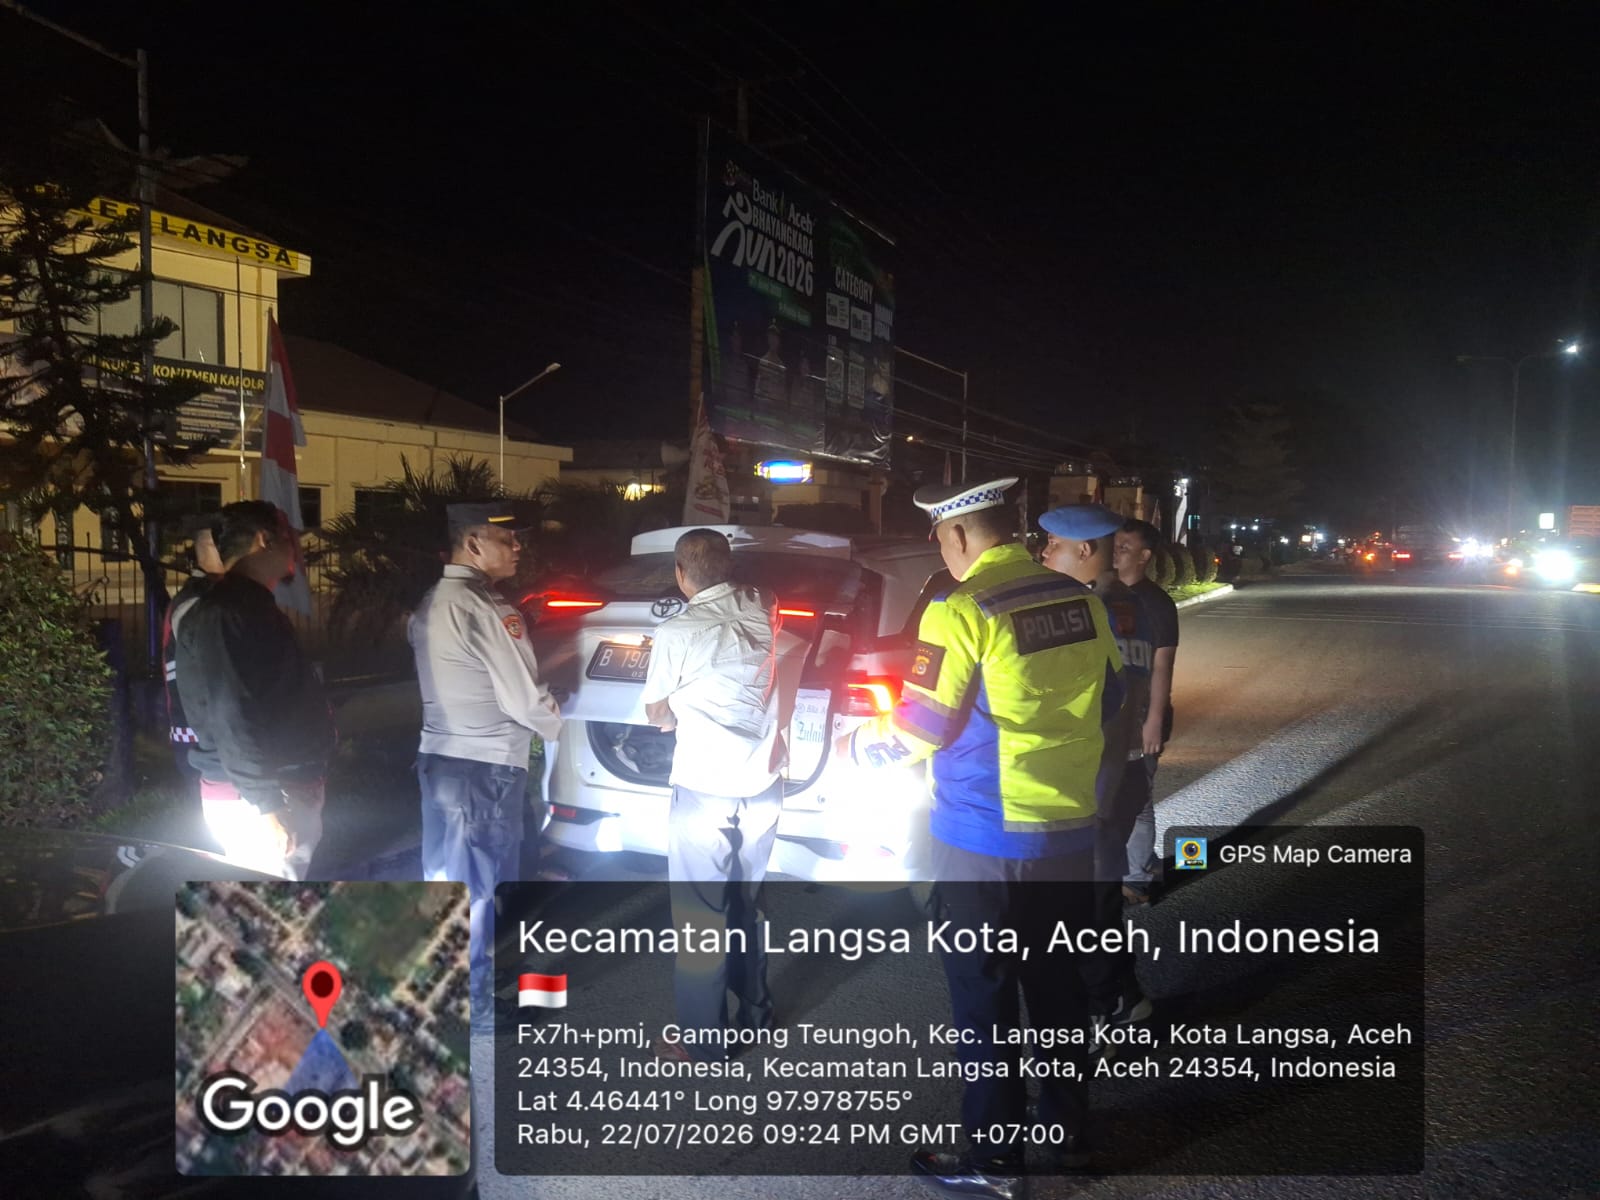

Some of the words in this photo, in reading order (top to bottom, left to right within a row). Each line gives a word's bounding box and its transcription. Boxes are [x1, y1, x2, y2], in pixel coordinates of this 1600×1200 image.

[752, 178, 779, 214] Bank
[788, 202, 814, 236] Aceh
[752, 205, 814, 259] BHAYANGKARA
[160, 215, 292, 267] LANGSA
[776, 245, 814, 297] 2026
[835, 265, 874, 305] CATEGORY
[1022, 607, 1090, 641] POLISI
[600, 648, 613, 667] B
